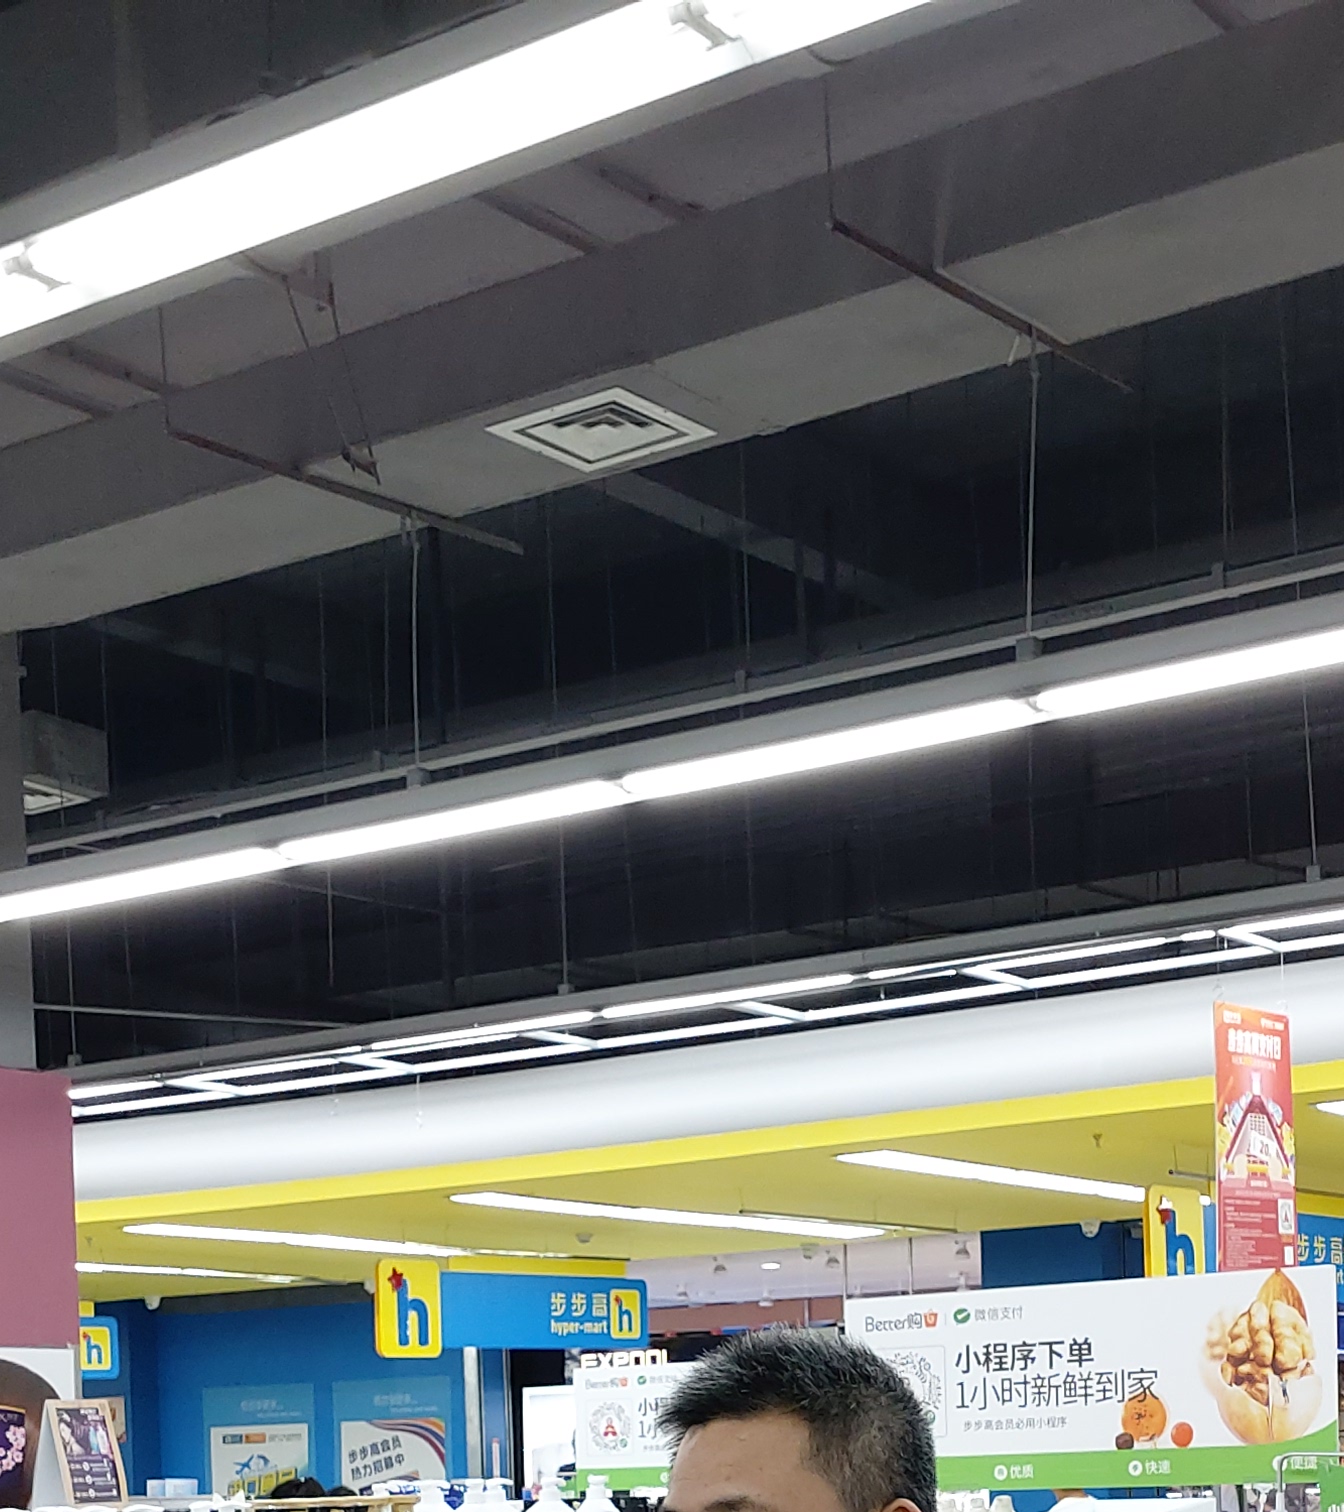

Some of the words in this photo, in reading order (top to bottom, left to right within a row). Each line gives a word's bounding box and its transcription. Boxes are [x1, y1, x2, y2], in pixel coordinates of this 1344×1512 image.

[550, 1291, 608, 1318] 步步高
[974, 1305, 1023, 1322] 微信支付
[550, 1318, 608, 1337] hyper-mart
[954, 1336, 1096, 1375] 小程序下单
[955, 1367, 1159, 1412] 1小时新鲜到家
[963, 1416, 1068, 1432] 步步高会员必用小程序
[1010, 1463, 1035, 1480] 优质
[1145, 1459, 1172, 1476] 快速
